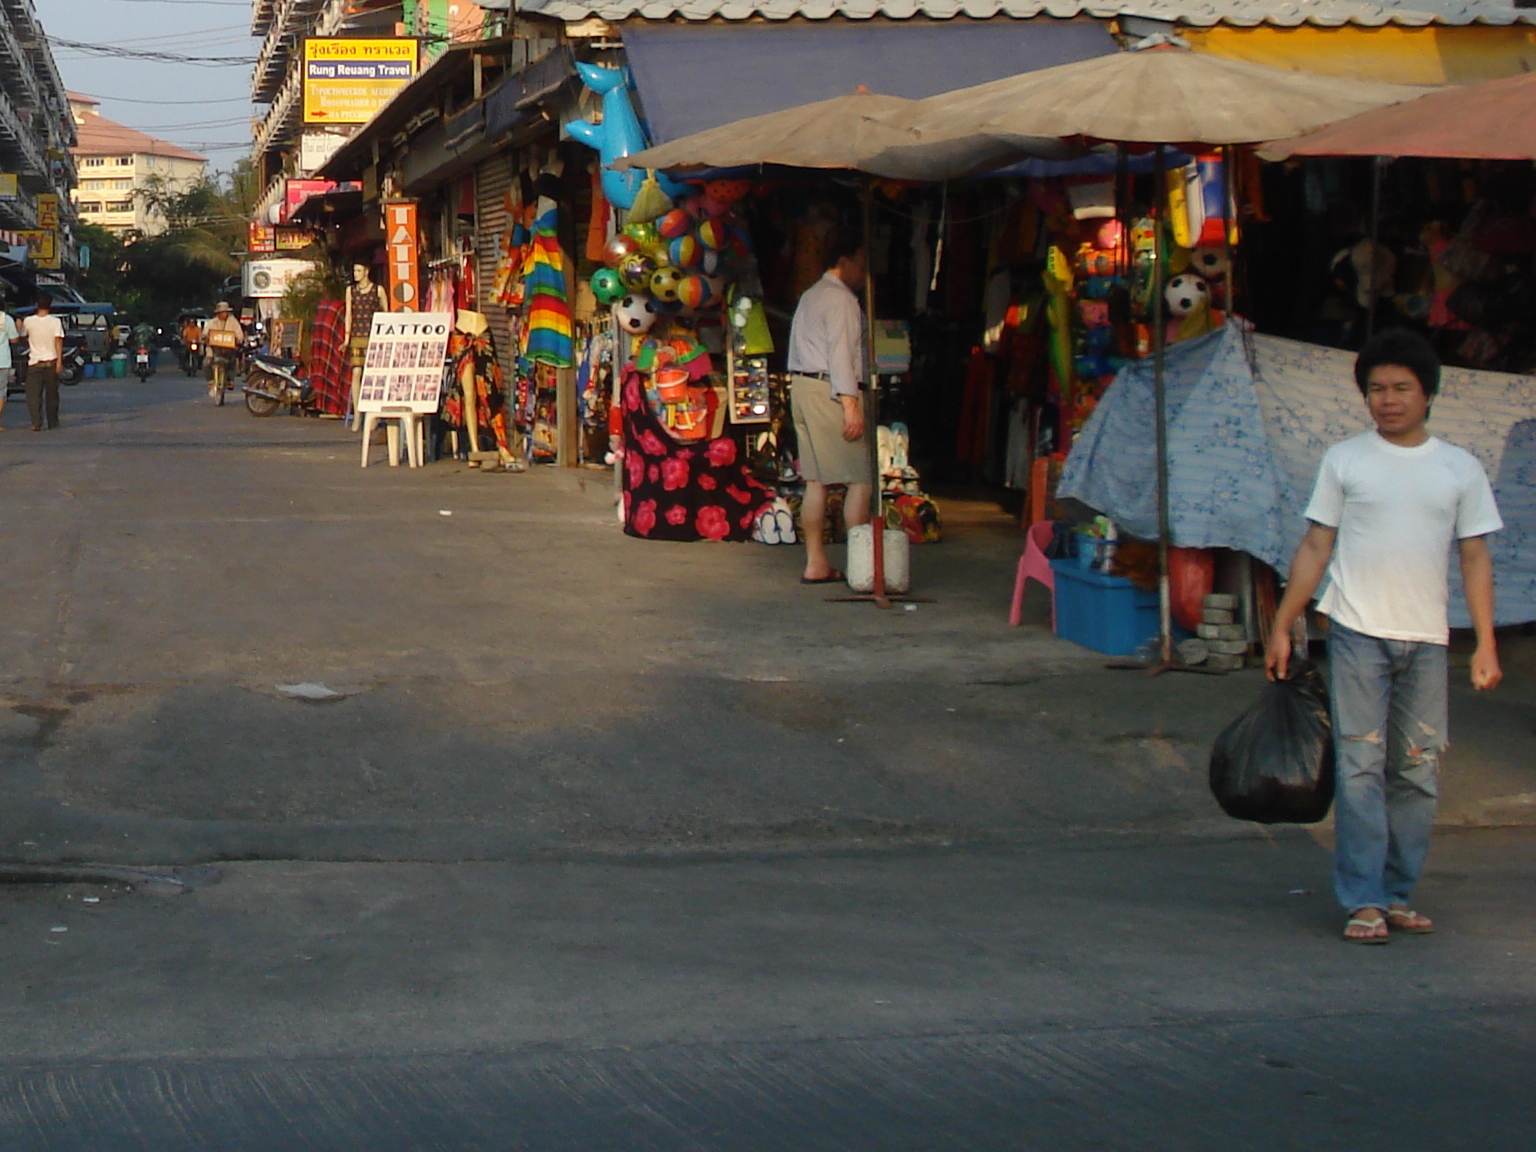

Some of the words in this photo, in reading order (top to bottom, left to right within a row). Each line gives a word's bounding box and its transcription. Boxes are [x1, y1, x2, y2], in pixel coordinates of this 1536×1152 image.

[309, 64, 335, 77] Rung
[337, 64, 376, 77] Reuang
[378, 64, 410, 75] Travel
[374, 323, 447, 337] TATTOO
